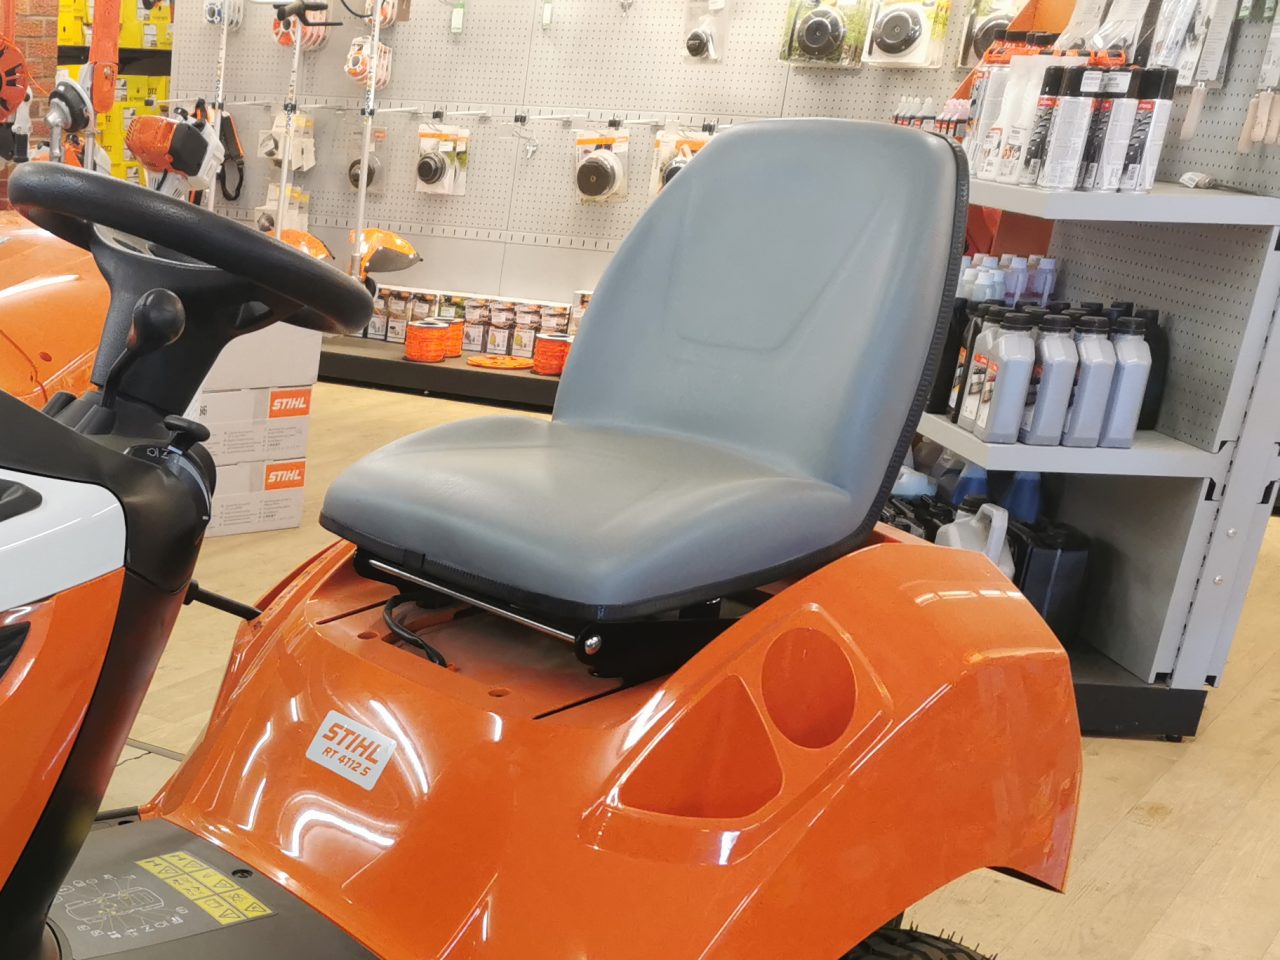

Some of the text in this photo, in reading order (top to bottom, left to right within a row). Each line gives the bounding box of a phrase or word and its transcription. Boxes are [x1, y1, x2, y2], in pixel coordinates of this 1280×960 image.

[272, 397, 307, 410] STIHL
[268, 470, 302, 483] STIHL
[322, 722, 381, 765] STIHL
[322, 746, 372, 777] RT 4112 S
